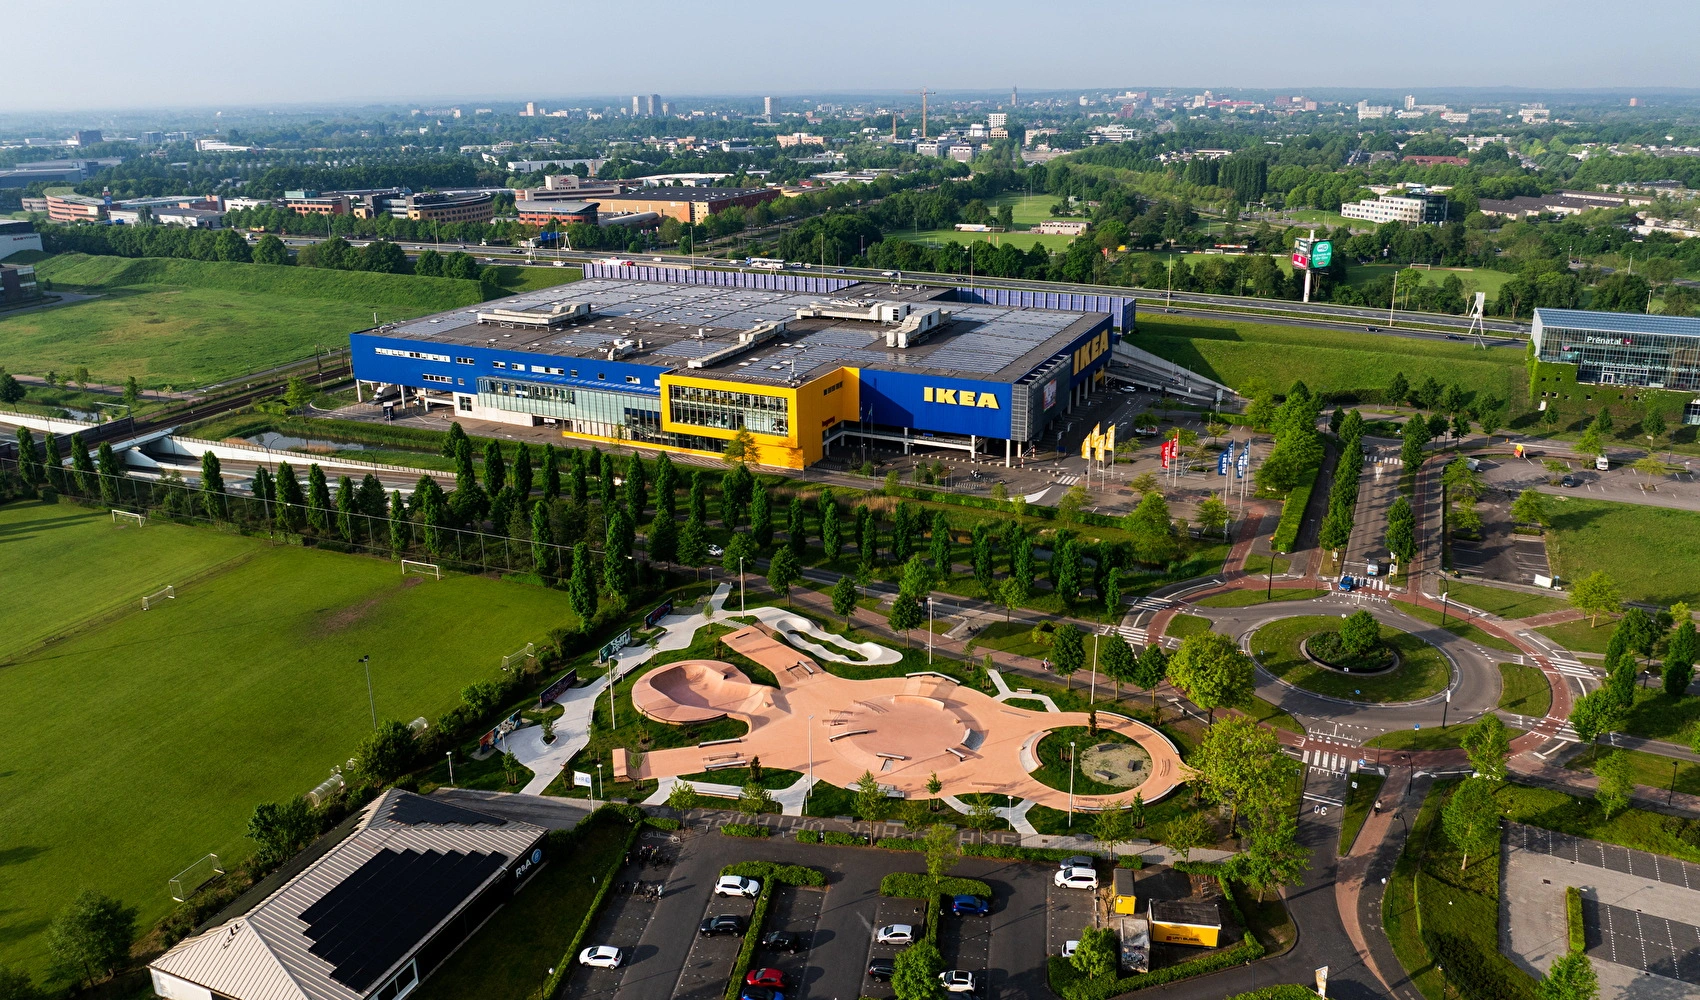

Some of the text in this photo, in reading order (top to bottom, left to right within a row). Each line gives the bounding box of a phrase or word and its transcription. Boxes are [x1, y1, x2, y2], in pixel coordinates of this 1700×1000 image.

[1586, 335, 1622, 345] Prénatal
[1073, 329, 1109, 376] IKEA
[923, 386, 1000, 410] IKEA
[1314, 805, 1328, 816] 30
